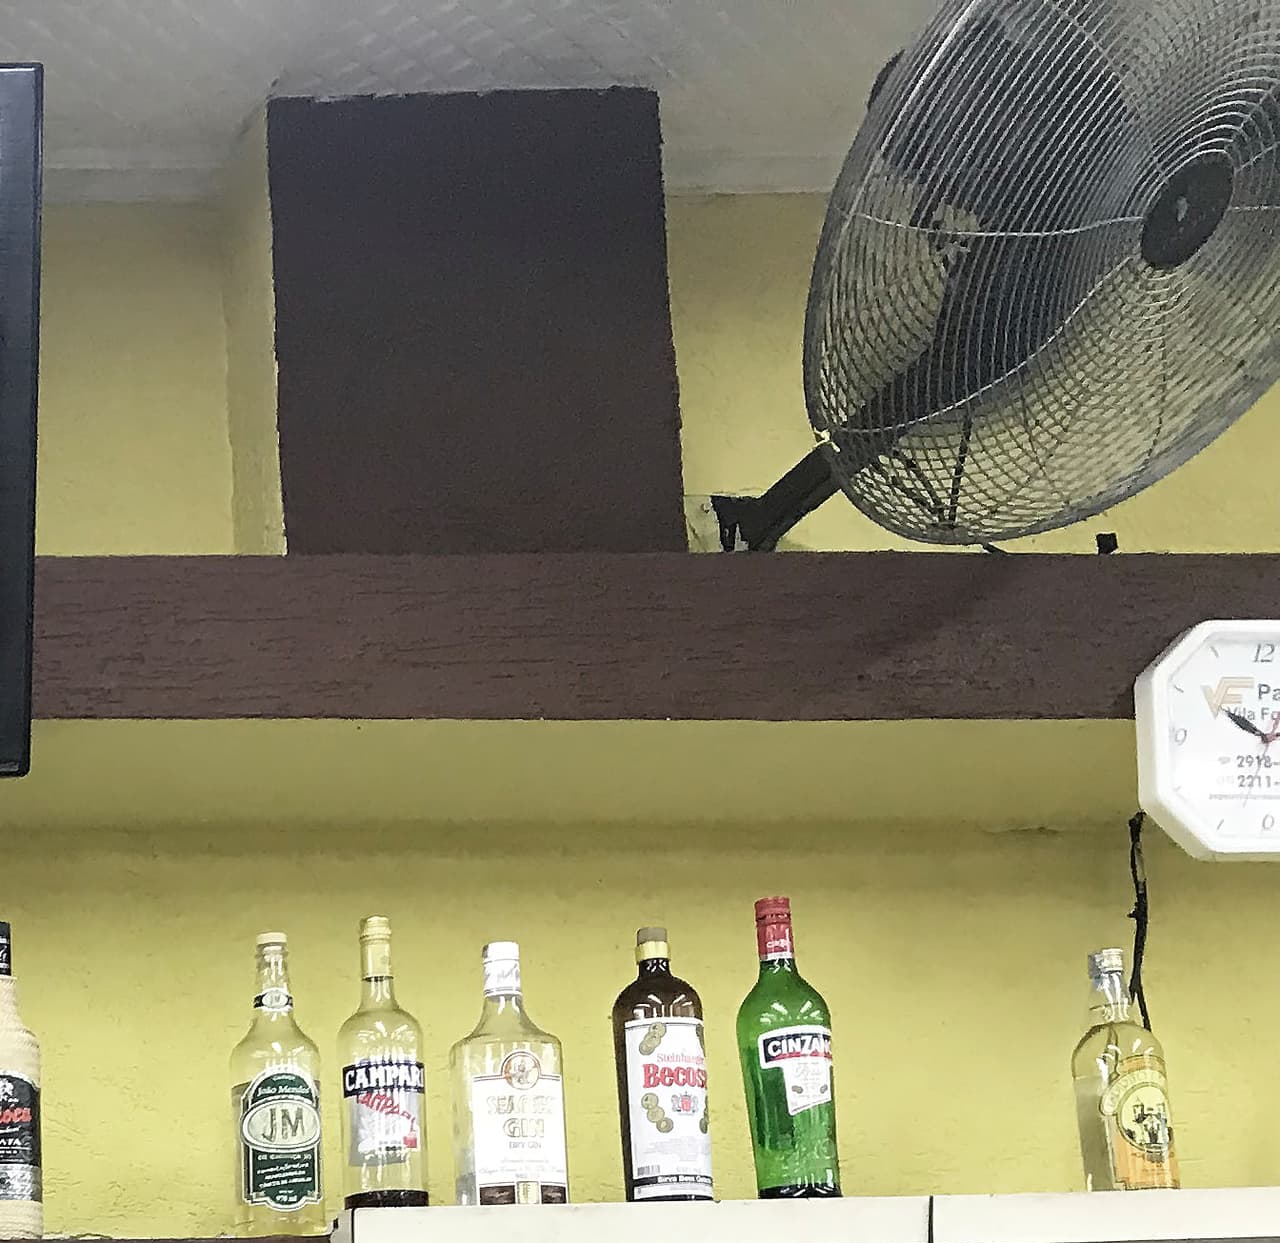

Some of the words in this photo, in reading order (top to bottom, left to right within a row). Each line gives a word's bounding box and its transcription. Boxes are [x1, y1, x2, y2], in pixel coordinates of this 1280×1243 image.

[1253, 643, 1275, 663] 12
[767, 1034, 831, 1058] CINZAN
[345, 1063, 424, 1092] CAMPARI
[262, 1106, 305, 1142] JM
[502, 1117, 545, 1138] GIN
